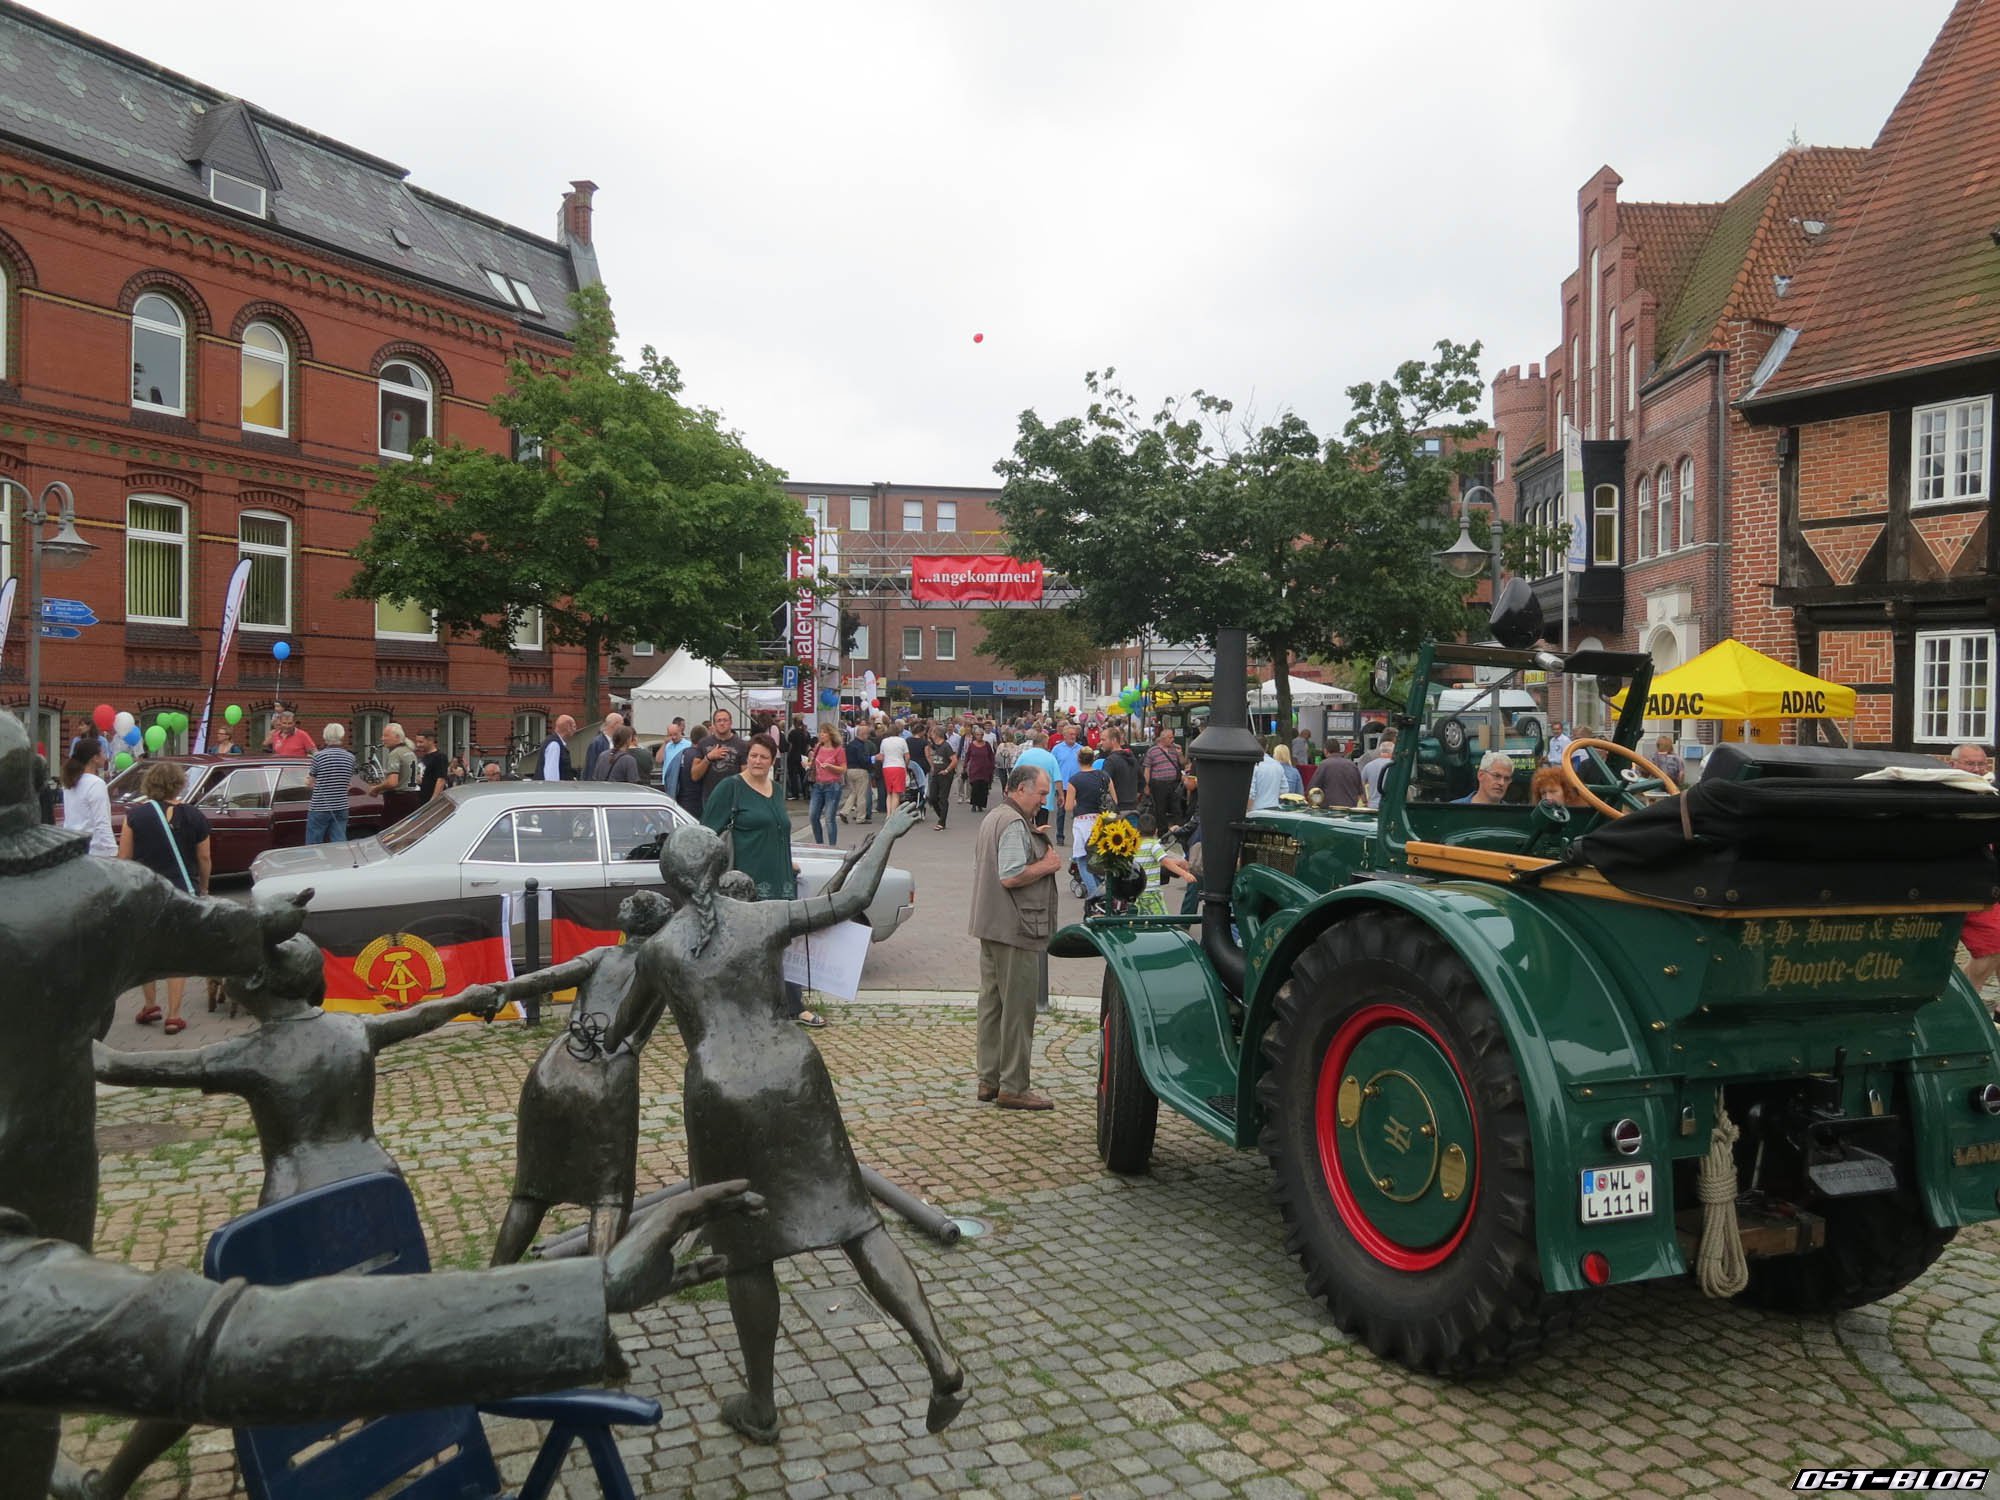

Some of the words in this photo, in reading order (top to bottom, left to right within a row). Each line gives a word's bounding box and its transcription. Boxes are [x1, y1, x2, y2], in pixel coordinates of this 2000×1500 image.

[919, 569, 1037, 587] ...angekommen!
[1647, 692, 1704, 716] ADAC
[1780, 690, 1826, 714] ADAC
[1802, 918, 1865, 948] Harms
[1869, 917, 1885, 941] &
[1889, 914, 1943, 942] Söhne
[1761, 951, 1904, 992] Hoopte-Elbe
[1610, 1170, 1631, 1191] WL
